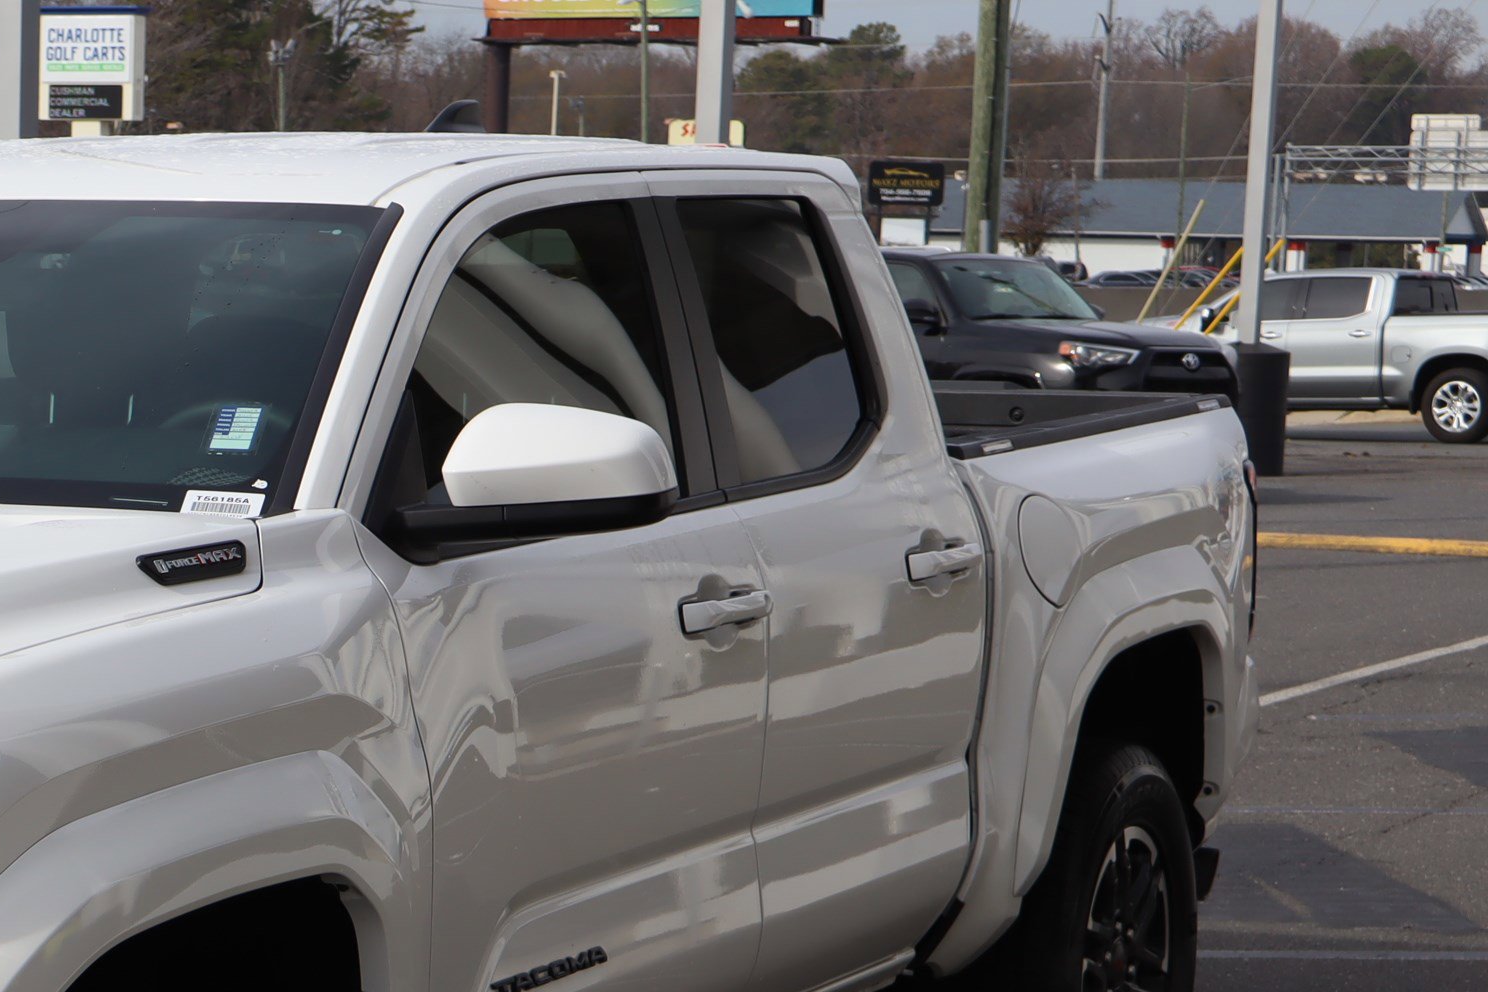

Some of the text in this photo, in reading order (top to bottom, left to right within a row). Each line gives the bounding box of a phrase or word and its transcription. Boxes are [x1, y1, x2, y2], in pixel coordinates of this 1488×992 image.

[47, 28, 125, 43] CHARLOTTE
[46, 46, 126, 61] GOLF CARTS
[50, 87, 95, 96] CUSHMAN
[50, 97, 111, 107] COMMERCIAL
[50, 108, 86, 117] DEALER
